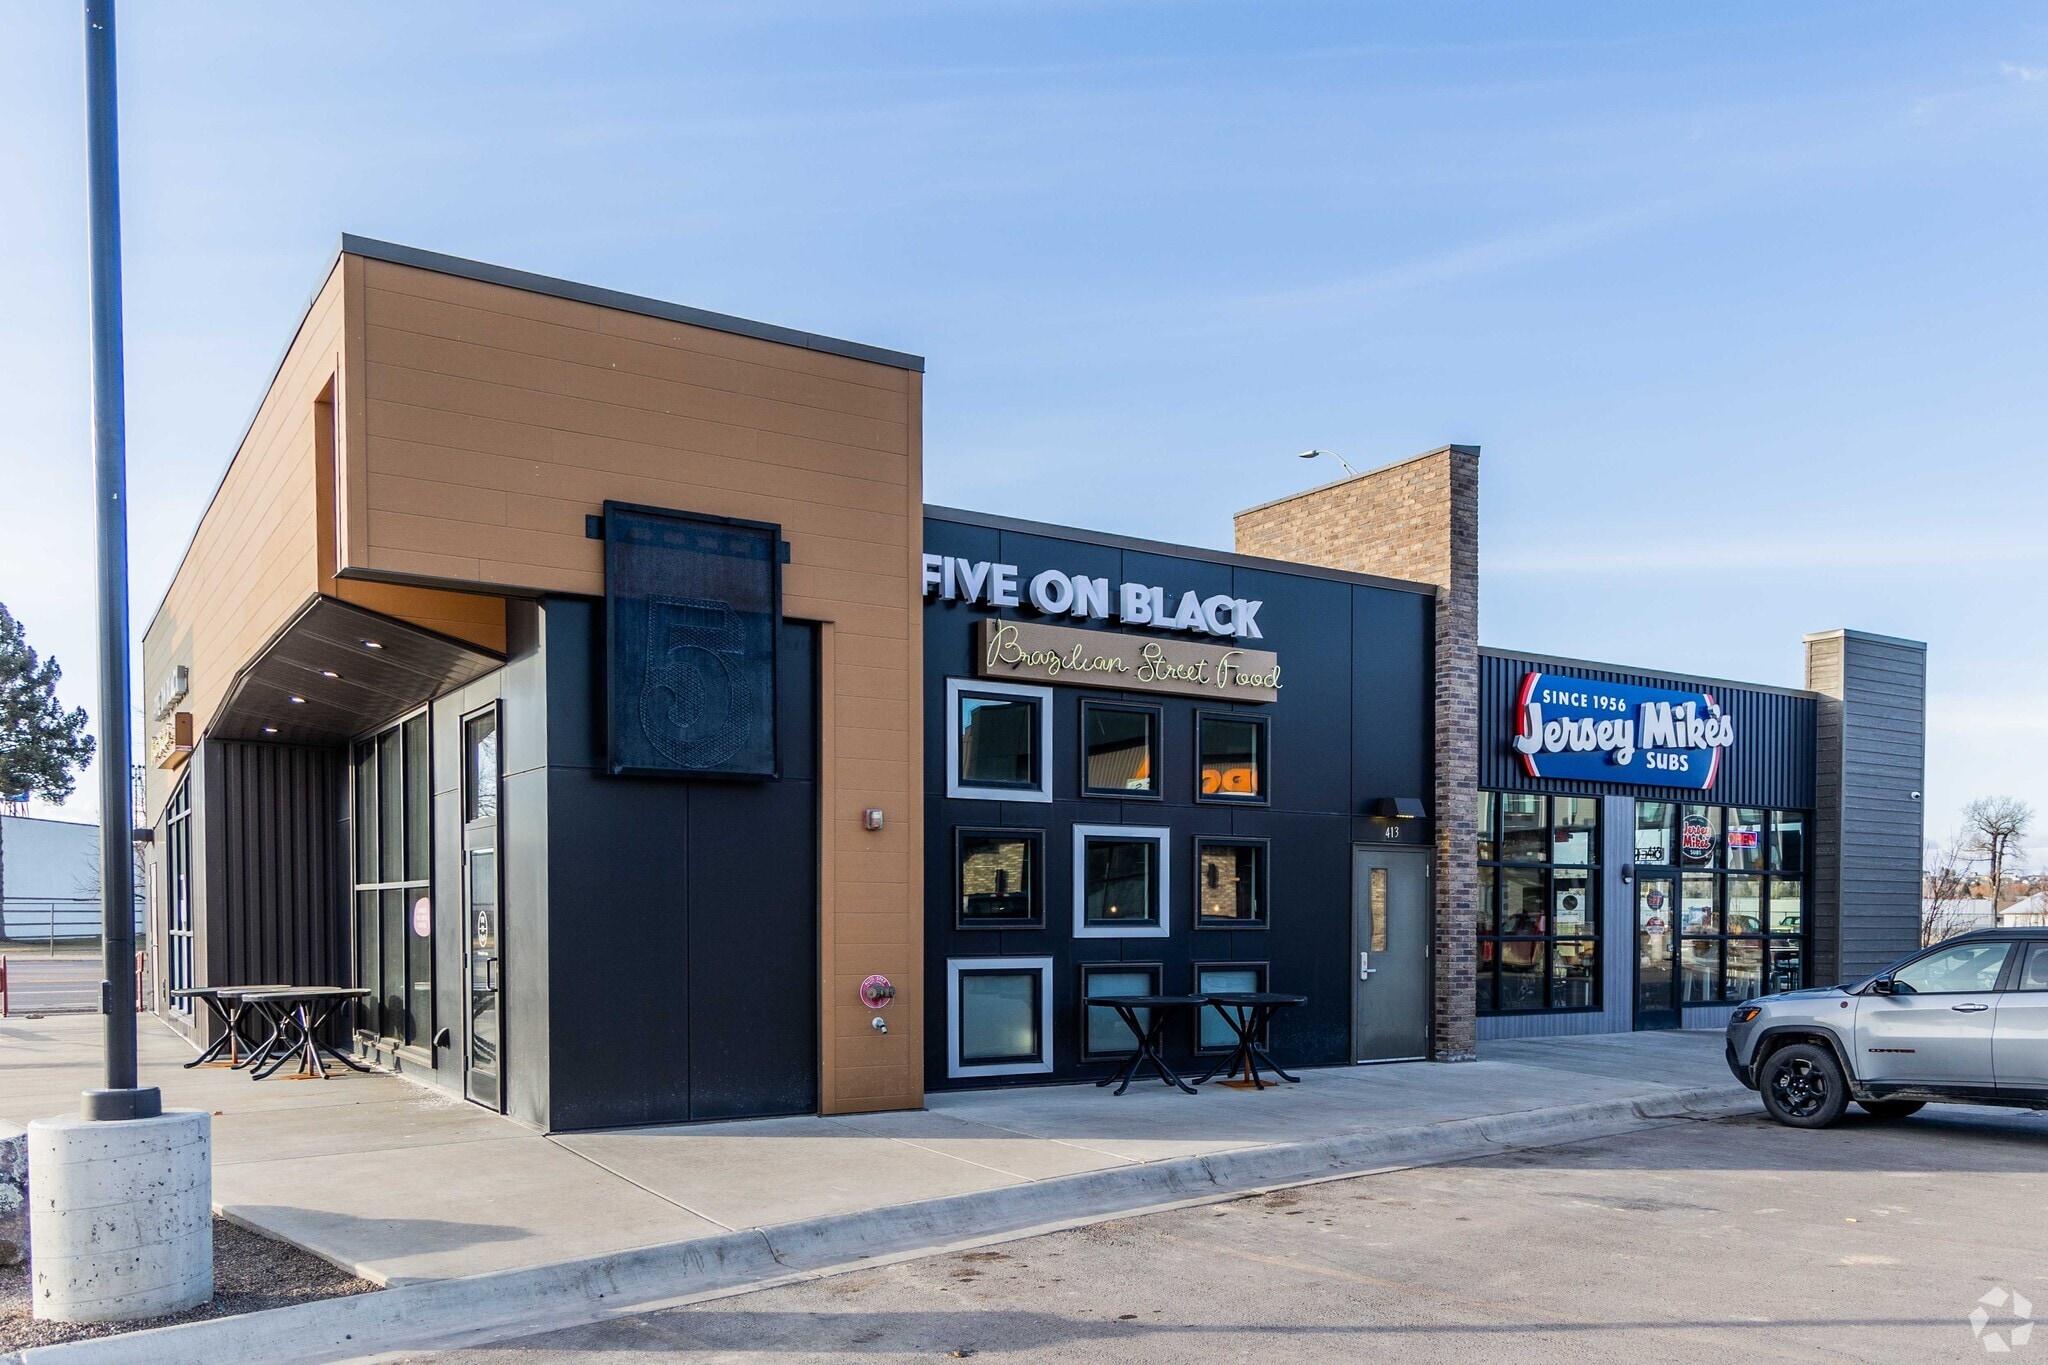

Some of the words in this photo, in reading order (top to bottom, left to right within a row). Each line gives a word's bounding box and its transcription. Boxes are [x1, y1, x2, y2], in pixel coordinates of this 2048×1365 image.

[923, 553, 1019, 607] FIVE
[1029, 569, 1109, 619] ON
[1120, 582, 1264, 639] BLACK
[987, 618, 1130, 675] Brazilian
[1137, 642, 1210, 682] Street
[1217, 651, 1283, 689] Food
[639, 592, 753, 769] 5
[1543, 689, 1588, 708] SINCE
[1593, 695, 1627, 712] 1956
[1513, 702, 1636, 765] Jersey
[1638, 701, 1734, 750] Mike's
[1646, 751, 1689, 772] SUBS
[1385, 826, 1399, 839] 413
[1683, 821, 1712, 838] Jersey
[1728, 832, 1756, 846] OPEN
